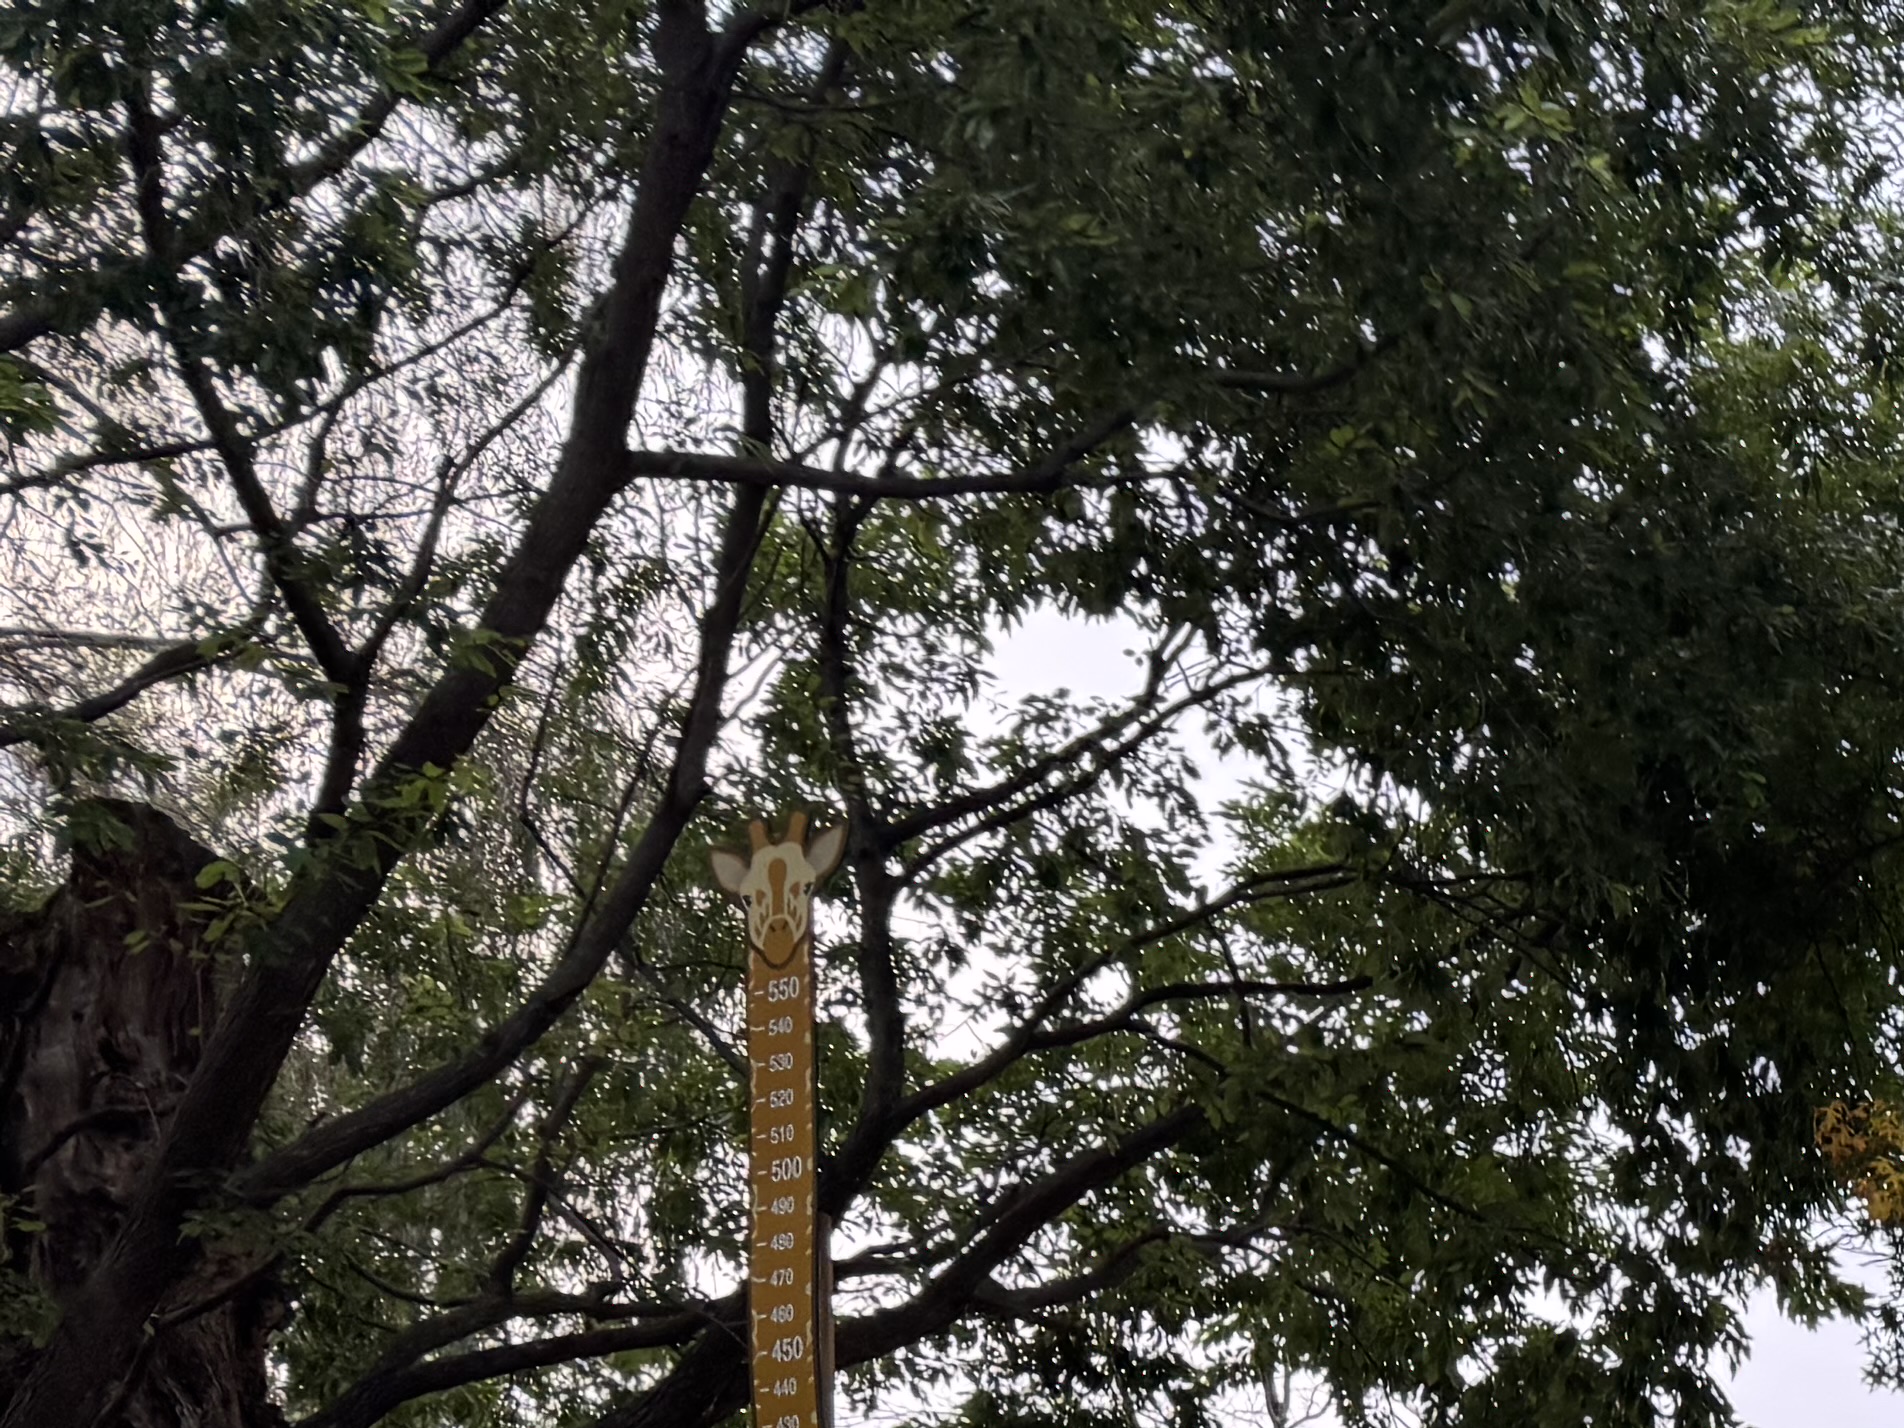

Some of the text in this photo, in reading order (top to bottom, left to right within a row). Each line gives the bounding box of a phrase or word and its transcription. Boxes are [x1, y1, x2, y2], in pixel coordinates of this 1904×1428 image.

[767, 976, 800, 1003] 550
[768, 1015, 793, 1036] 540
[769, 1088, 794, 1109] 520
[770, 1123, 795, 1144] 510
[771, 1155, 803, 1183] 500
[770, 1195, 795, 1215] 490
[770, 1267, 794, 1287] 470
[771, 1335, 804, 1363] 450
[773, 1377, 797, 1397] 440
